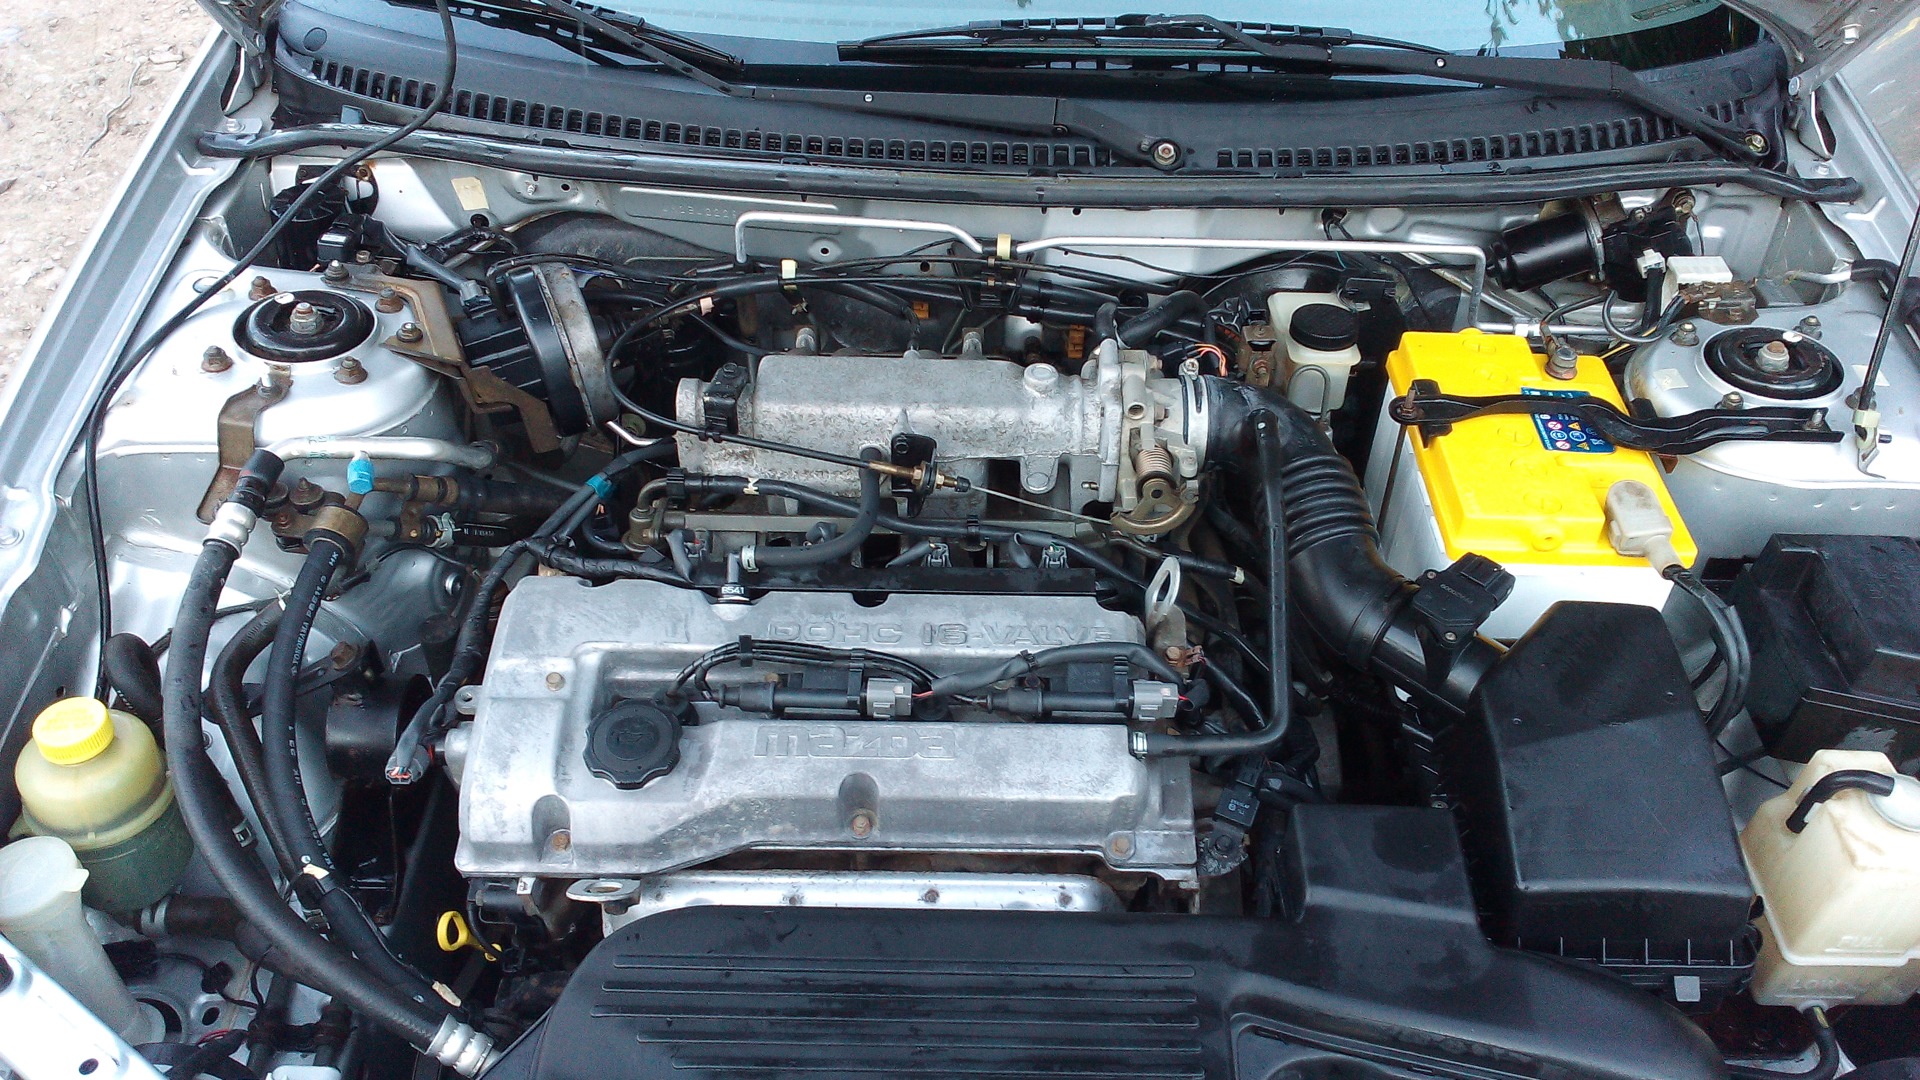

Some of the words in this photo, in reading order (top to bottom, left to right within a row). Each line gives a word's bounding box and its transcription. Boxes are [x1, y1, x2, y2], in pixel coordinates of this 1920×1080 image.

[292, 621, 310, 665] YOKOHAMA
[767, 621, 903, 645] DOHC
[923, 622, 1112, 646] 16-VALVE
